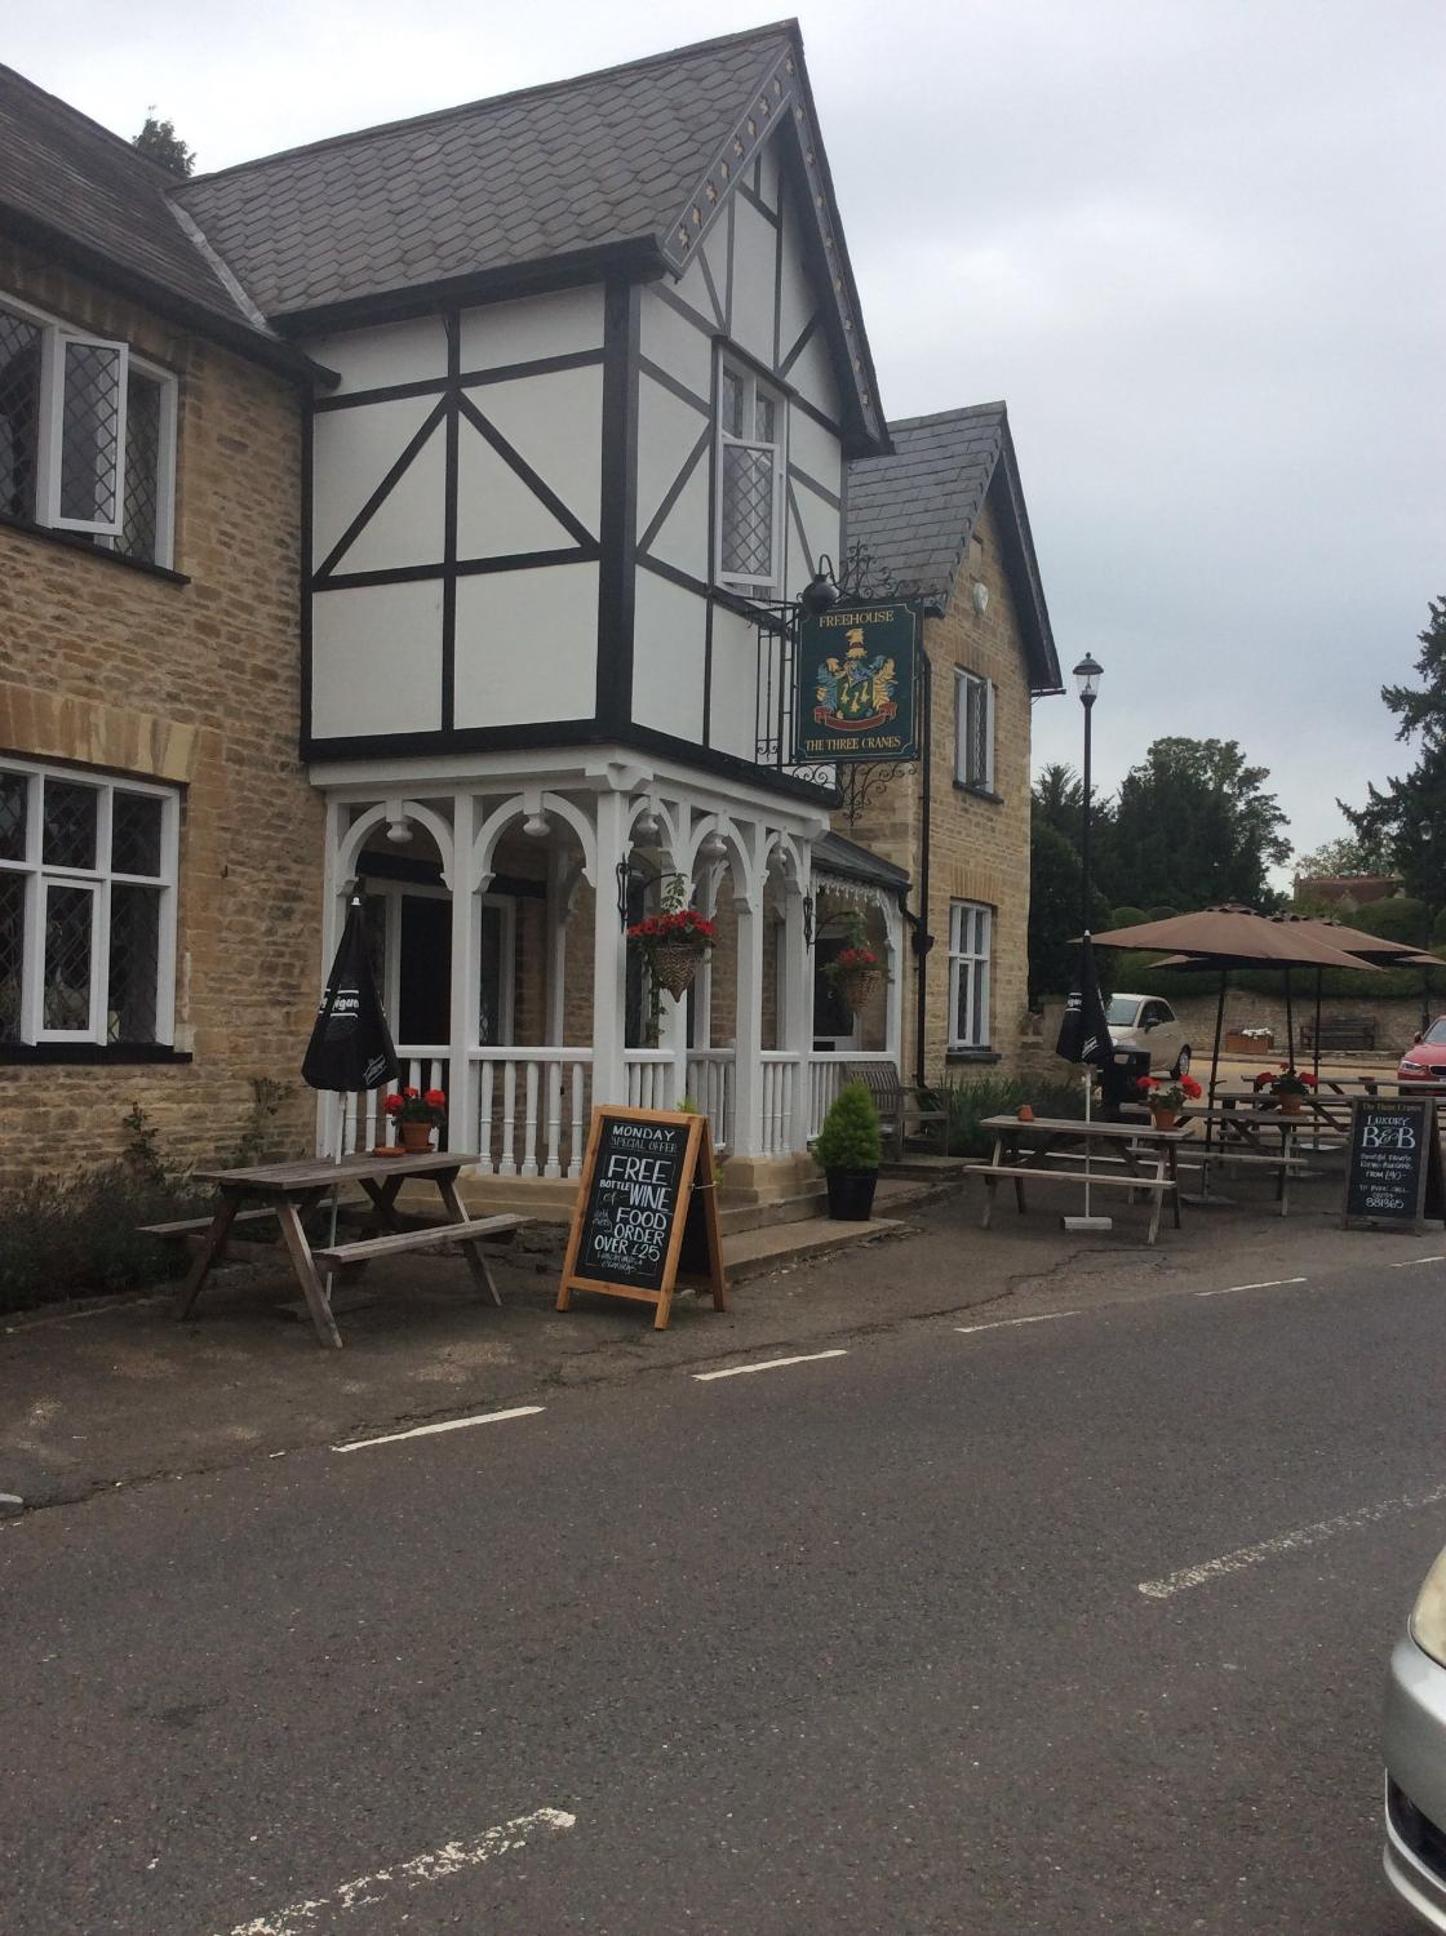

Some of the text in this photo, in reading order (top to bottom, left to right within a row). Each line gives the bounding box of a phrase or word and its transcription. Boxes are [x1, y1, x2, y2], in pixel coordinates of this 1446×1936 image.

[819, 610, 895, 628] FREEHOUSE
[806, 735, 901, 751] THE THREE CRANES
[610, 1135, 676, 1153] SPECIAL OFFER
[612, 1125, 675, 1142] MONDAY
[1362, 1126, 1416, 1149] B&B
[607, 1154, 673, 1186] FREE
[599, 1178, 631, 1191] BOTTLE
[629, 1183, 673, 1213] WINE
[615, 1206, 667, 1230] FOOD
[614, 1223, 665, 1247] ORDER
[594, 1234, 629, 1255] OVER
[631, 1243, 661, 1262] £25
